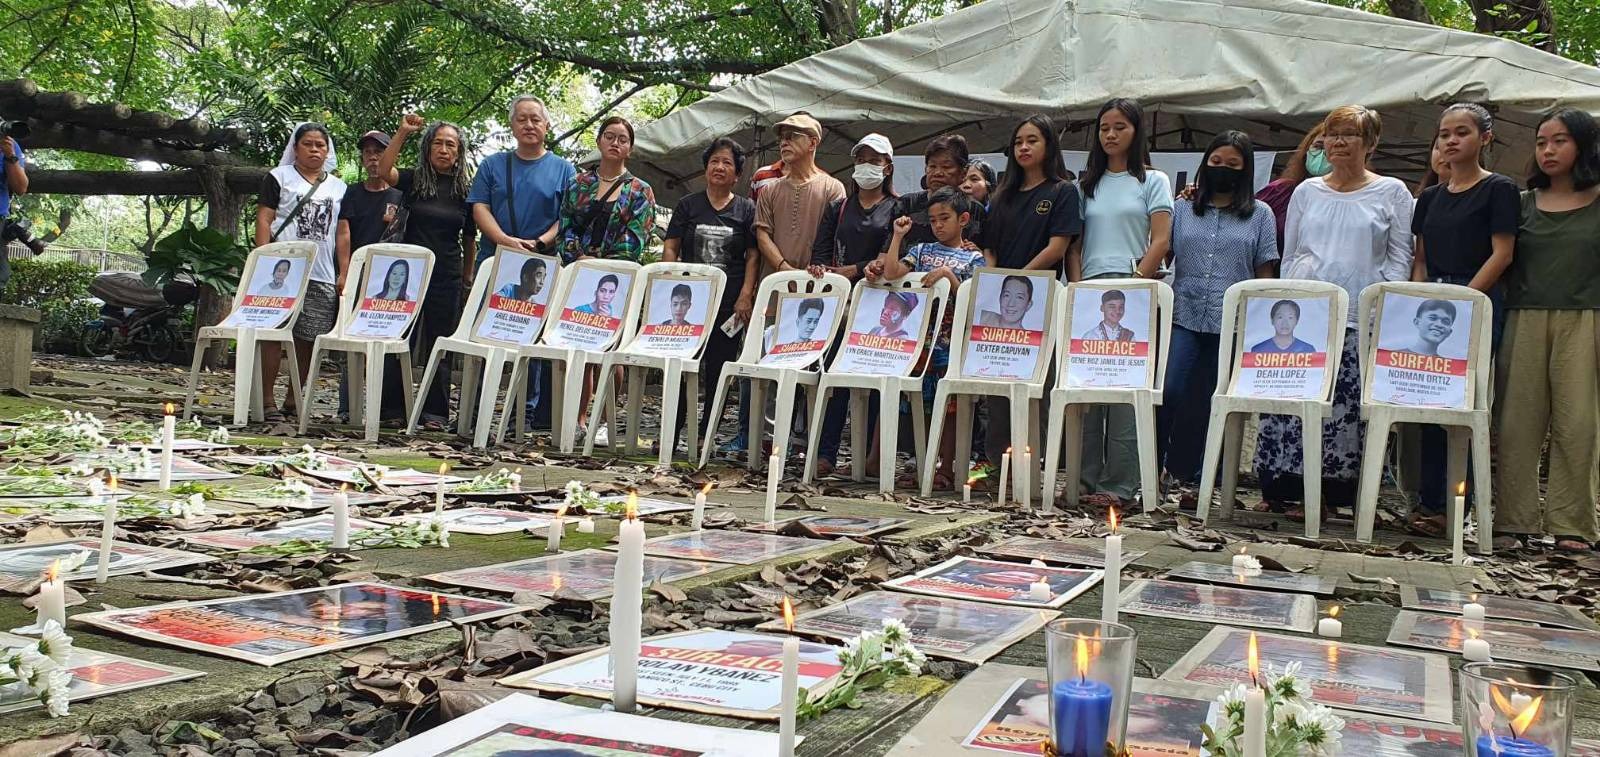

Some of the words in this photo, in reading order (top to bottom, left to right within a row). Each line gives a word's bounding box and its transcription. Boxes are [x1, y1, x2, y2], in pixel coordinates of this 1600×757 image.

[249, 296, 289, 308] SURFACE
[369, 298, 409, 312] SURFACE
[497, 297, 537, 315] SURFACE
[494, 312, 509, 321] ARIEL
[569, 310, 612, 329] SURFACE
[652, 325, 695, 336] SURFACE
[981, 327, 1033, 344] SURFACE
[780, 341, 819, 353] SURFACE
[858, 334, 906, 351] SURFACE
[1082, 340, 1137, 355] SURFACE
[976, 343, 1000, 354] DEXTER
[1000, 345, 1031, 357] CAPUYAN
[1127, 359, 1146, 367] JESUS
[1254, 353, 1313, 367] SURFACE
[1389, 351, 1453, 374] SURFACE
[1256, 369, 1279, 378] DEAH
[1280, 369, 1307, 378] LOPEZ
[1388, 369, 1425, 382] NORMAN
[1426, 373, 1451, 386] ORTIZ
